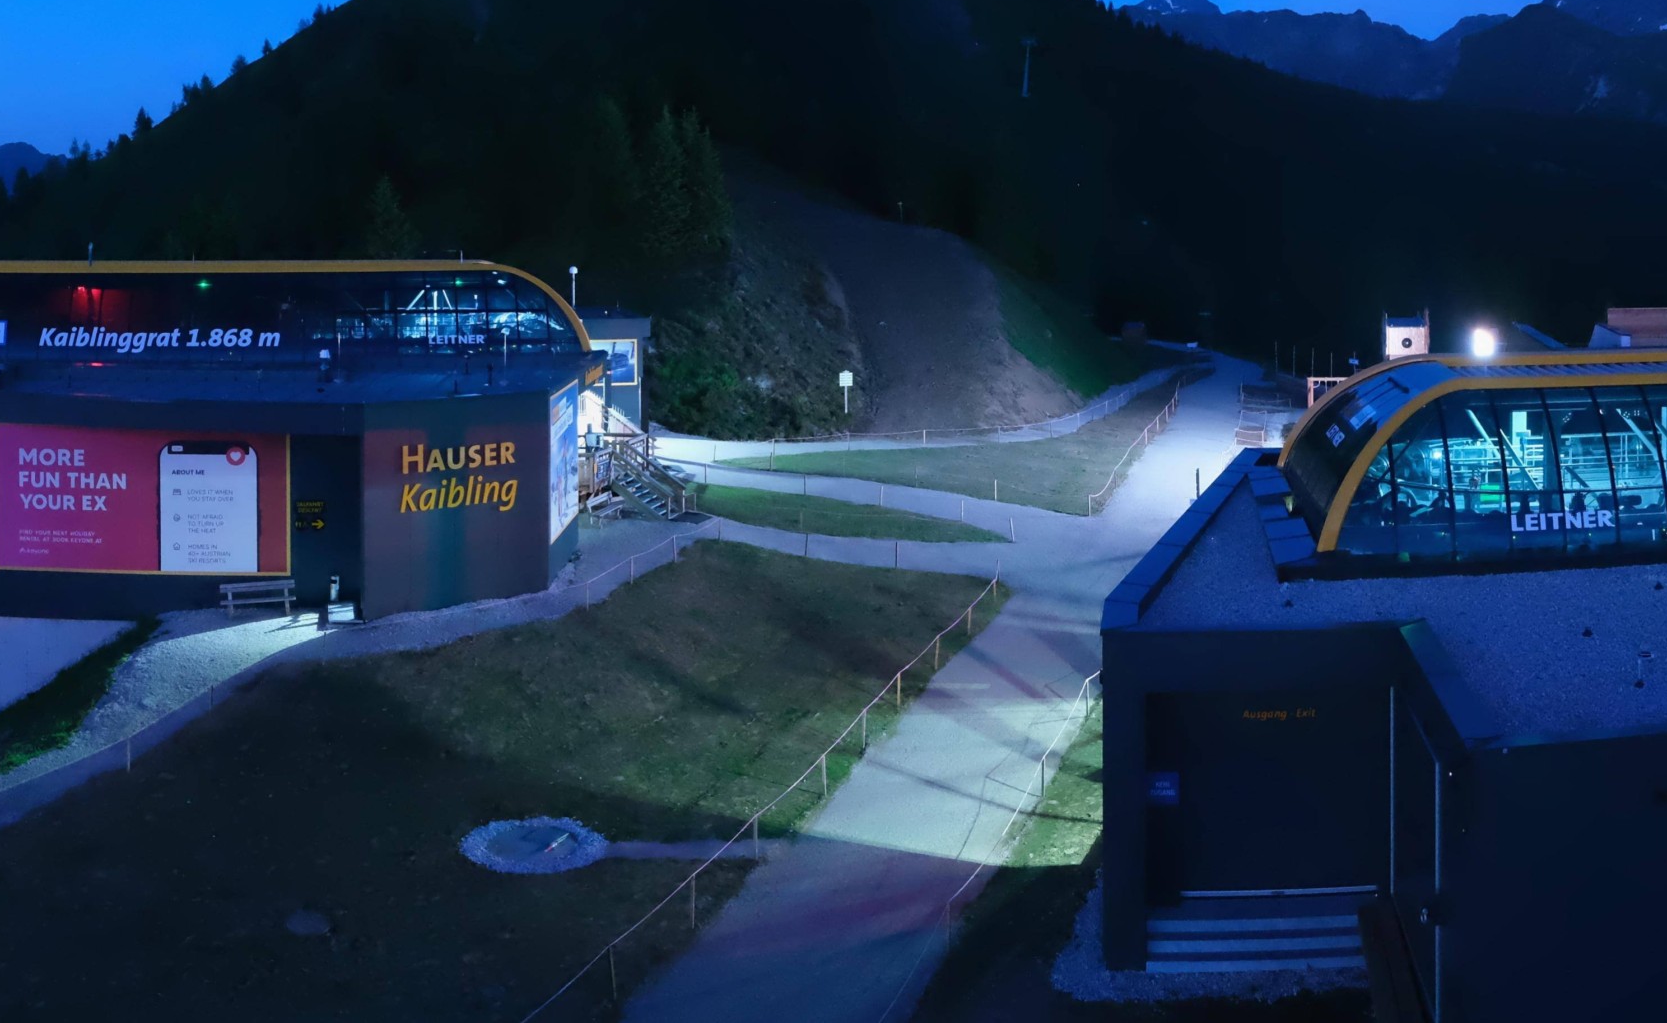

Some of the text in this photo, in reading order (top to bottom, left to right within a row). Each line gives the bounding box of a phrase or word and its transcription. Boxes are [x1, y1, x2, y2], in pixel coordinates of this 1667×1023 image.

[39, 327, 280, 354] Kaiblinggrat 1.868 m
[428, 334, 485, 344] LEITNER
[19, 448, 85, 466] MORE
[402, 441, 516, 475] HAUSER
[19, 471, 127, 489] FUN THAN
[20, 493, 107, 511] YOUR EX
[400, 475, 518, 513] Kaibling
[1511, 510, 1616, 532] LEITNER
[1243, 709, 1288, 721] Ausgang
[1296, 708, 1316, 718] Exit
